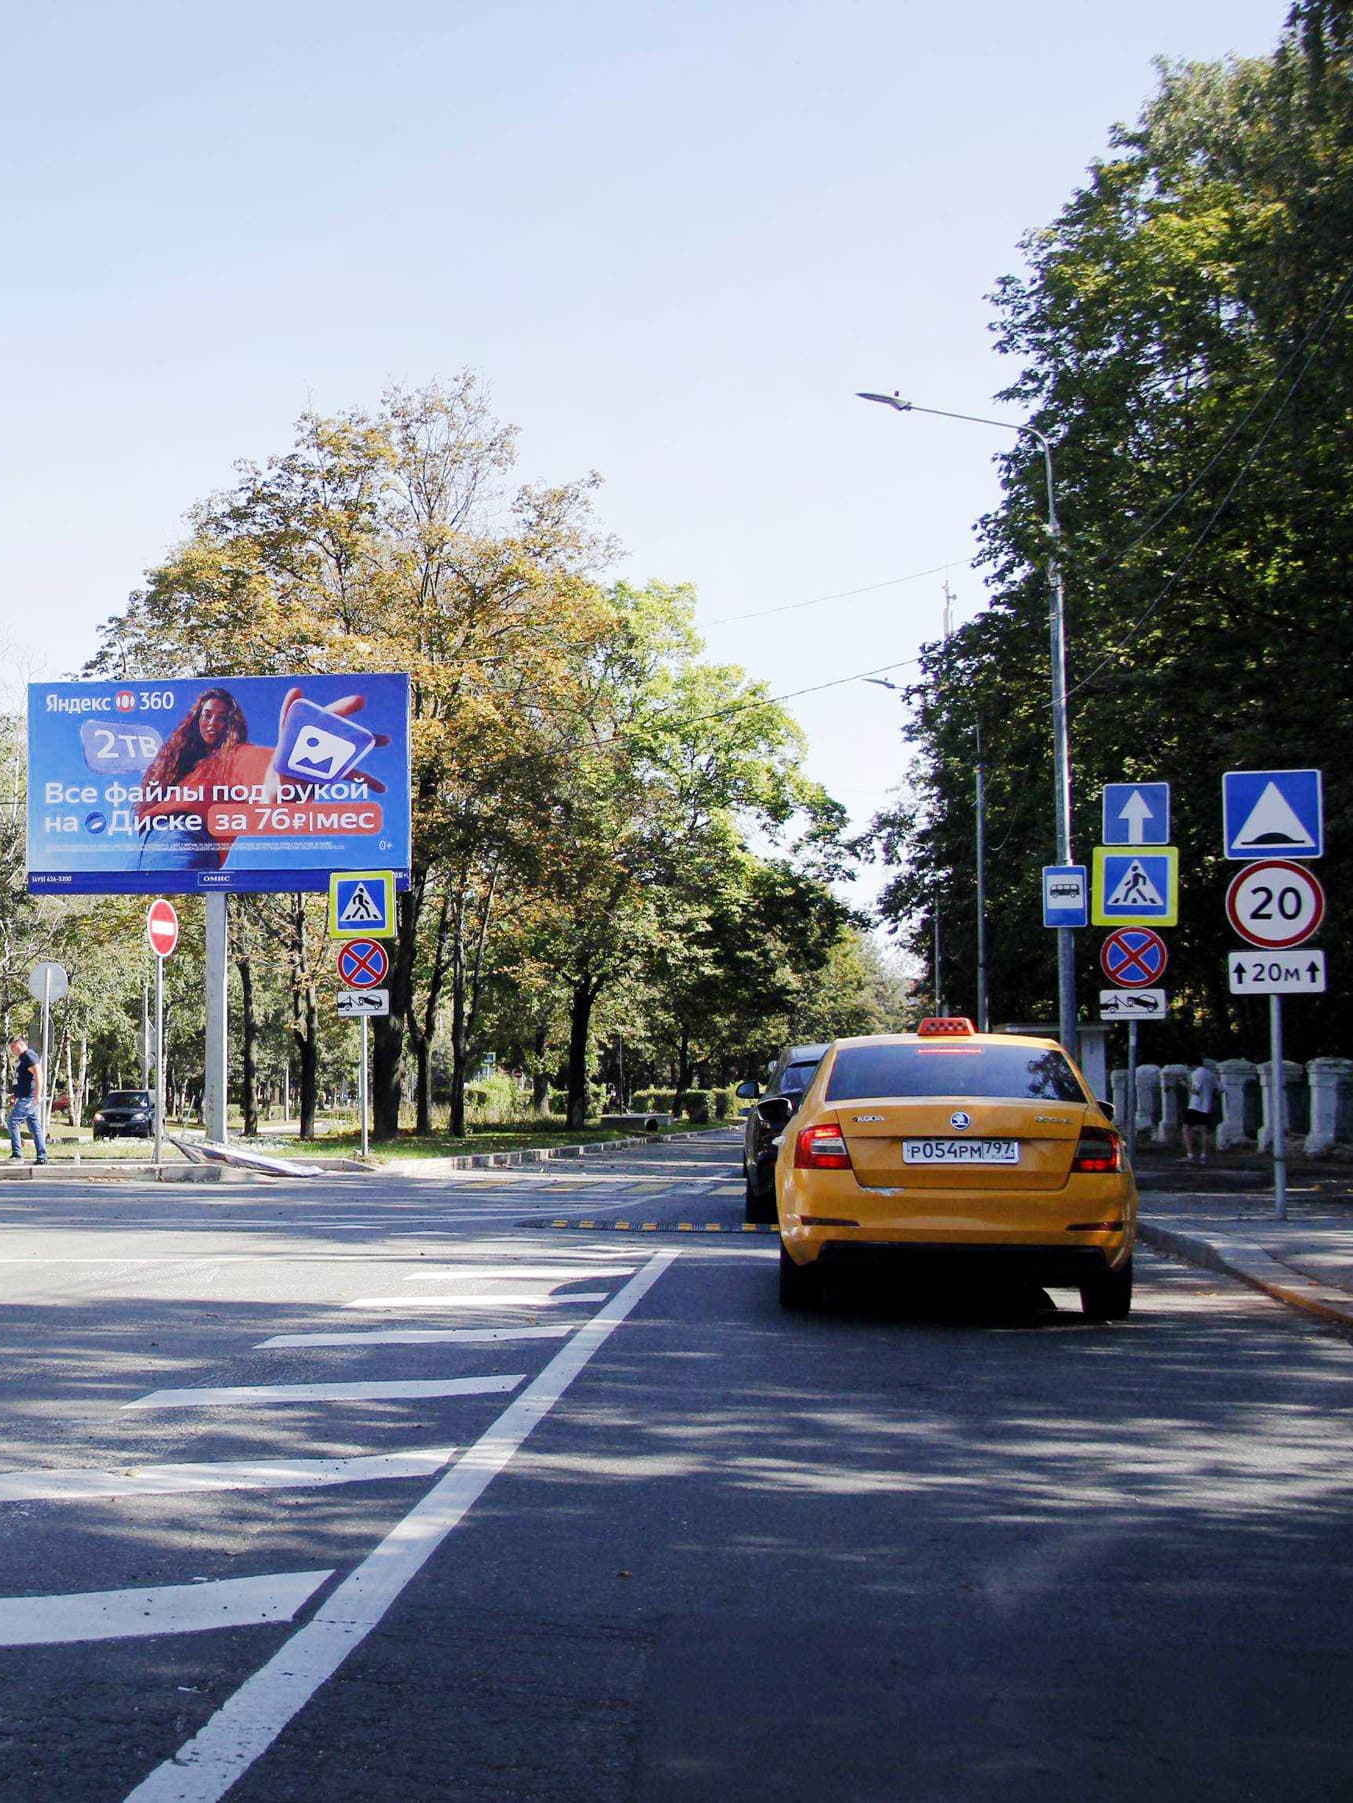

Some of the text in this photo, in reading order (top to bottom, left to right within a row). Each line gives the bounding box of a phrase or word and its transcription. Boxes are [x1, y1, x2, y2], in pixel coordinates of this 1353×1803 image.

[46, 691, 175, 714] Яндекс 360
[45, 777, 368, 807] Все файлы под рукой
[45, 815, 78, 833] на
[108, 810, 203, 836] Диске
[215, 813, 247, 831] за
[1250, 886, 1302, 920] 20
